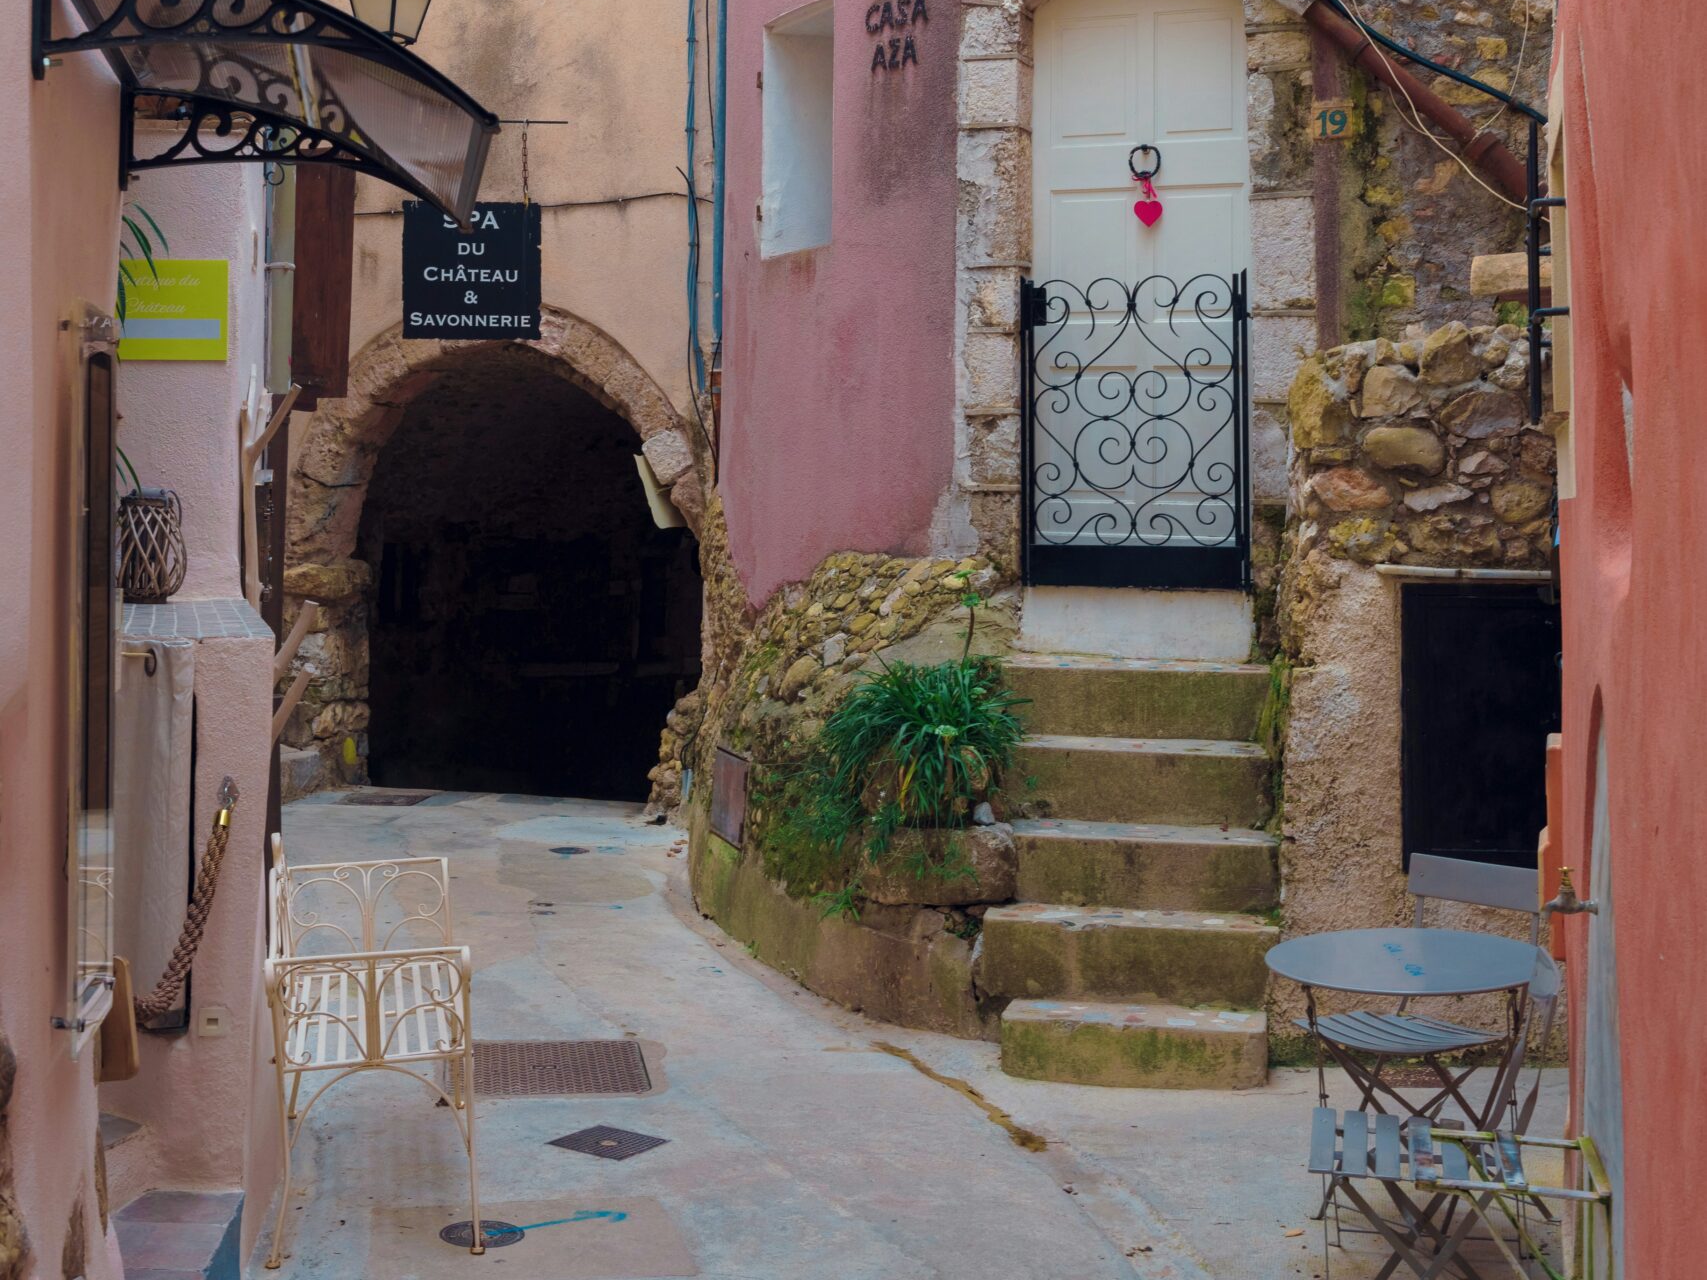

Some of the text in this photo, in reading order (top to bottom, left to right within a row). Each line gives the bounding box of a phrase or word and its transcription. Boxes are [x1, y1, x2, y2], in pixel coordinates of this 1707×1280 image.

[1316, 110, 1347, 137] 19
[457, 242, 485, 256] DU
[423, 264, 518, 282] CHÂTEAU
[463, 290, 479, 304] &
[409, 312, 531, 328] SAVONNERIE
